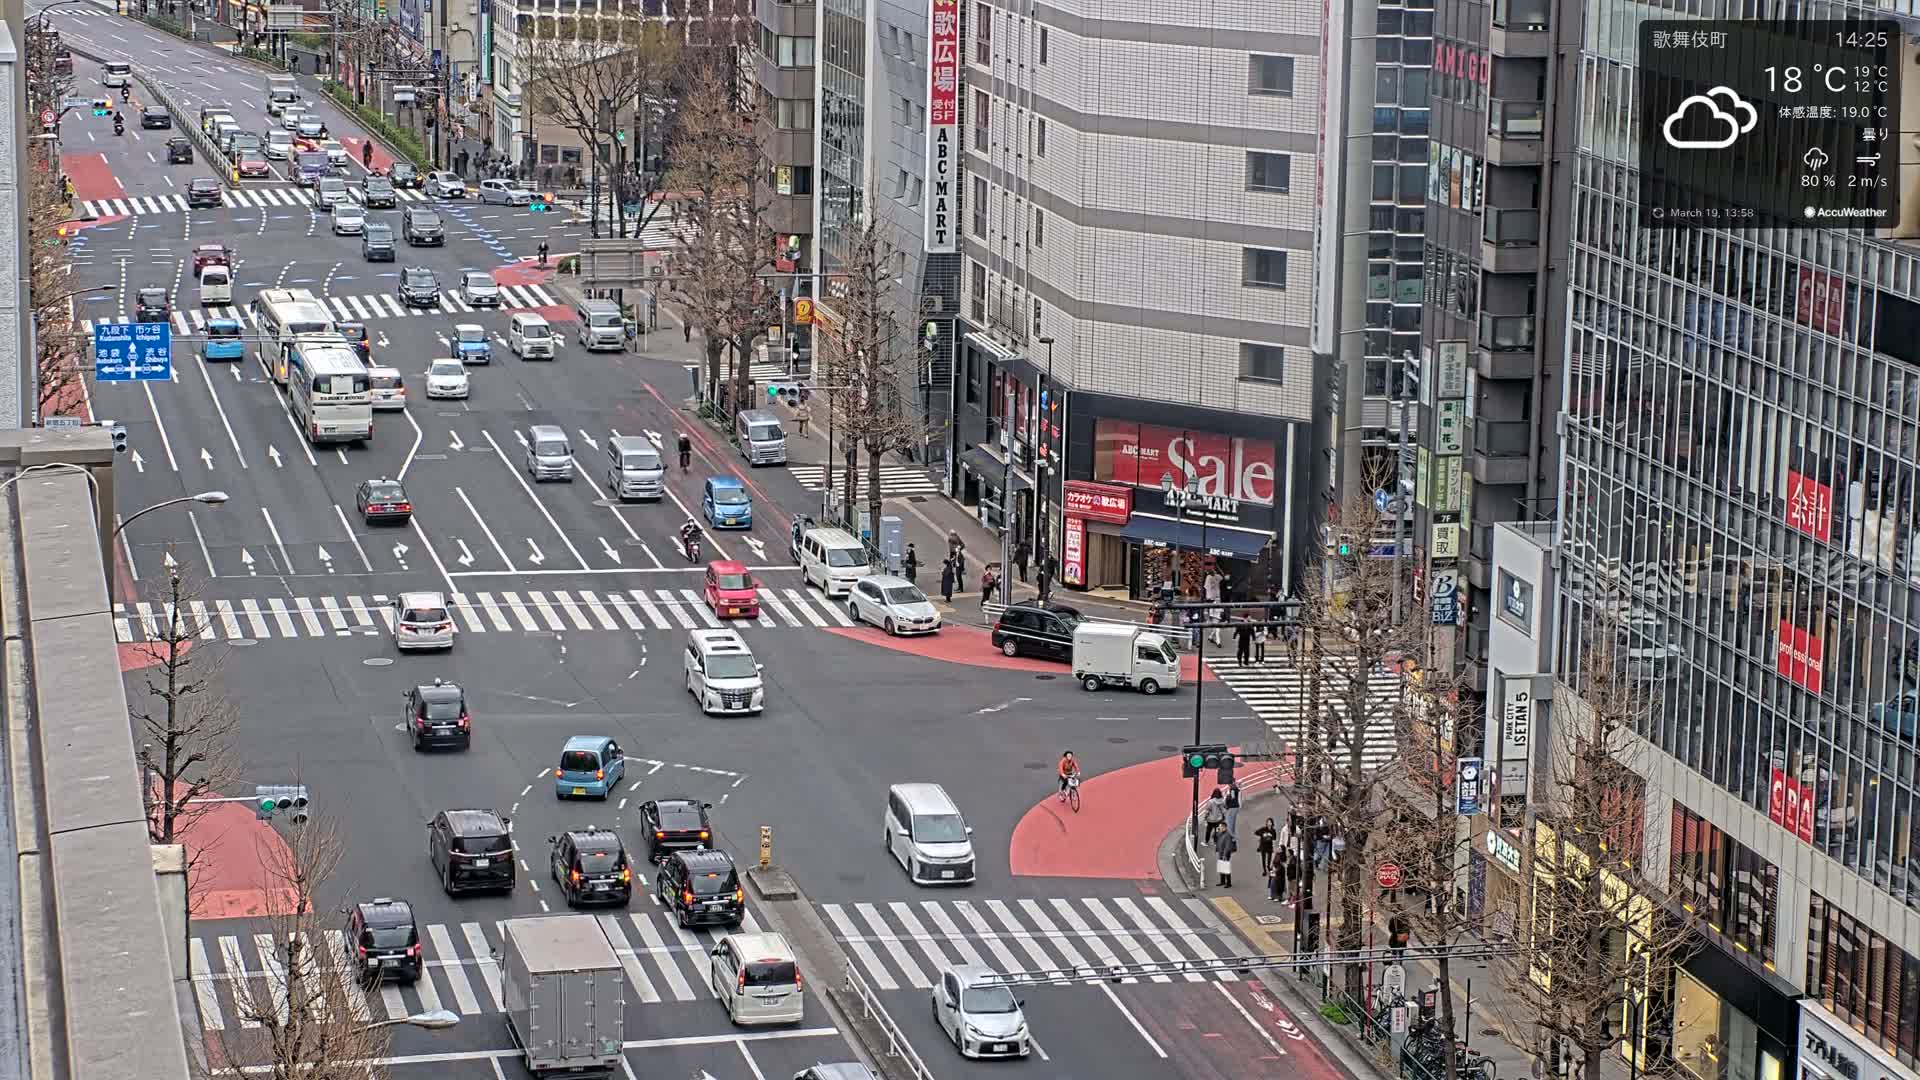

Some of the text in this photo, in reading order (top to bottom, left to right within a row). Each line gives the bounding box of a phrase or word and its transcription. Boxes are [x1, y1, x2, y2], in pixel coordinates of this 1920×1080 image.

[932, 100, 955, 110] 受付
[933, 111, 954, 121] 5F
[936, 127, 949, 245] ABC-MART
[102, 326, 129, 334] 九段下
[1122, 444, 1160, 457] ABCMART
[1168, 437, 1274, 502] Sale
[1791, 481, 1827, 532] 会計
[1436, 527, 1449, 554] 買取
[1779, 640, 1821, 671] professional
[1506, 703, 1515, 740] PARK CITY
[1514, 691, 1528, 746] ISETAN 5
[1773, 780, 1812, 829] CPA
